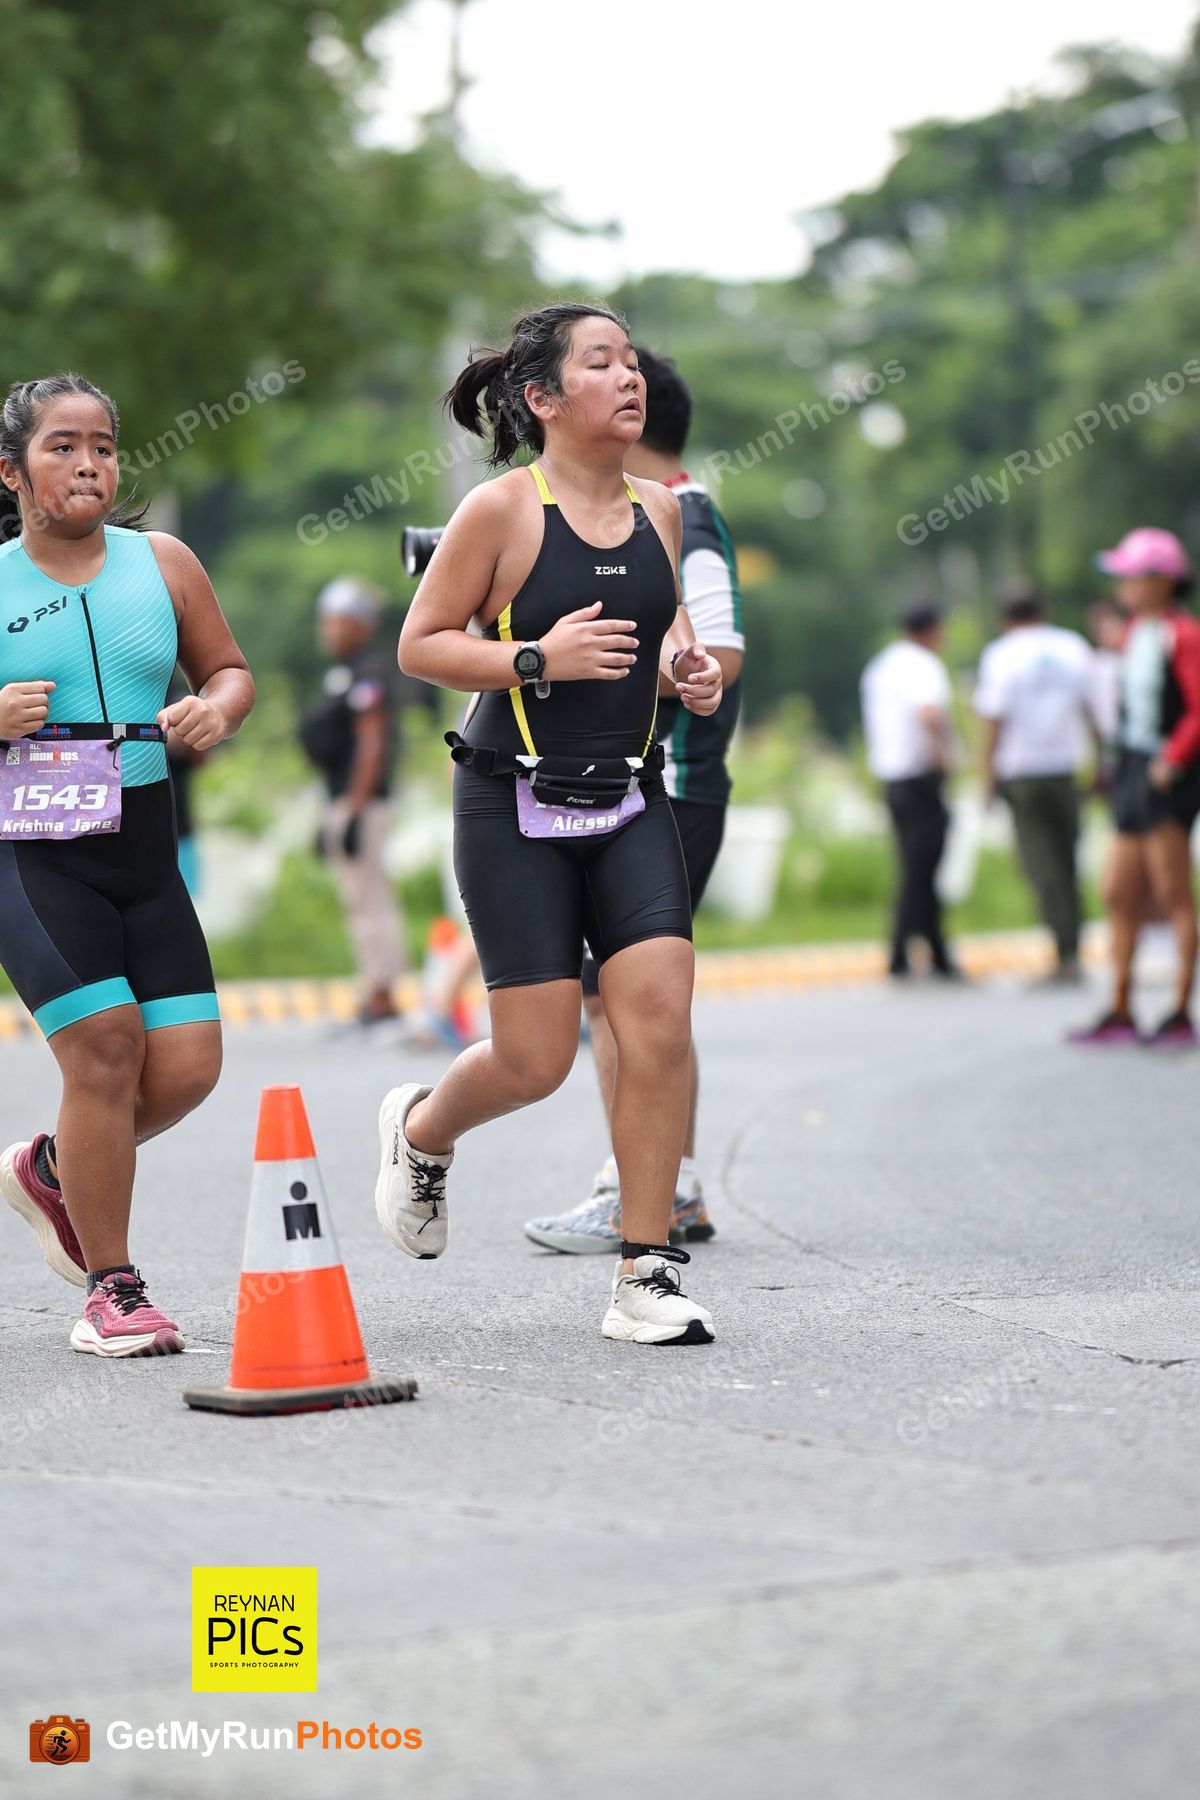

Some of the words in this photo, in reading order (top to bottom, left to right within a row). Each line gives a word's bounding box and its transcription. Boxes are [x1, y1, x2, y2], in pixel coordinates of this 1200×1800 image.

[594, 566, 627, 575] ZOKE
[33, 595, 67, 622] PSI
[13, 784, 109, 811] 1543
[2, 819, 64, 833] Krishna
[70, 818, 112, 832] Jane
[551, 814, 618, 832] Alessa
